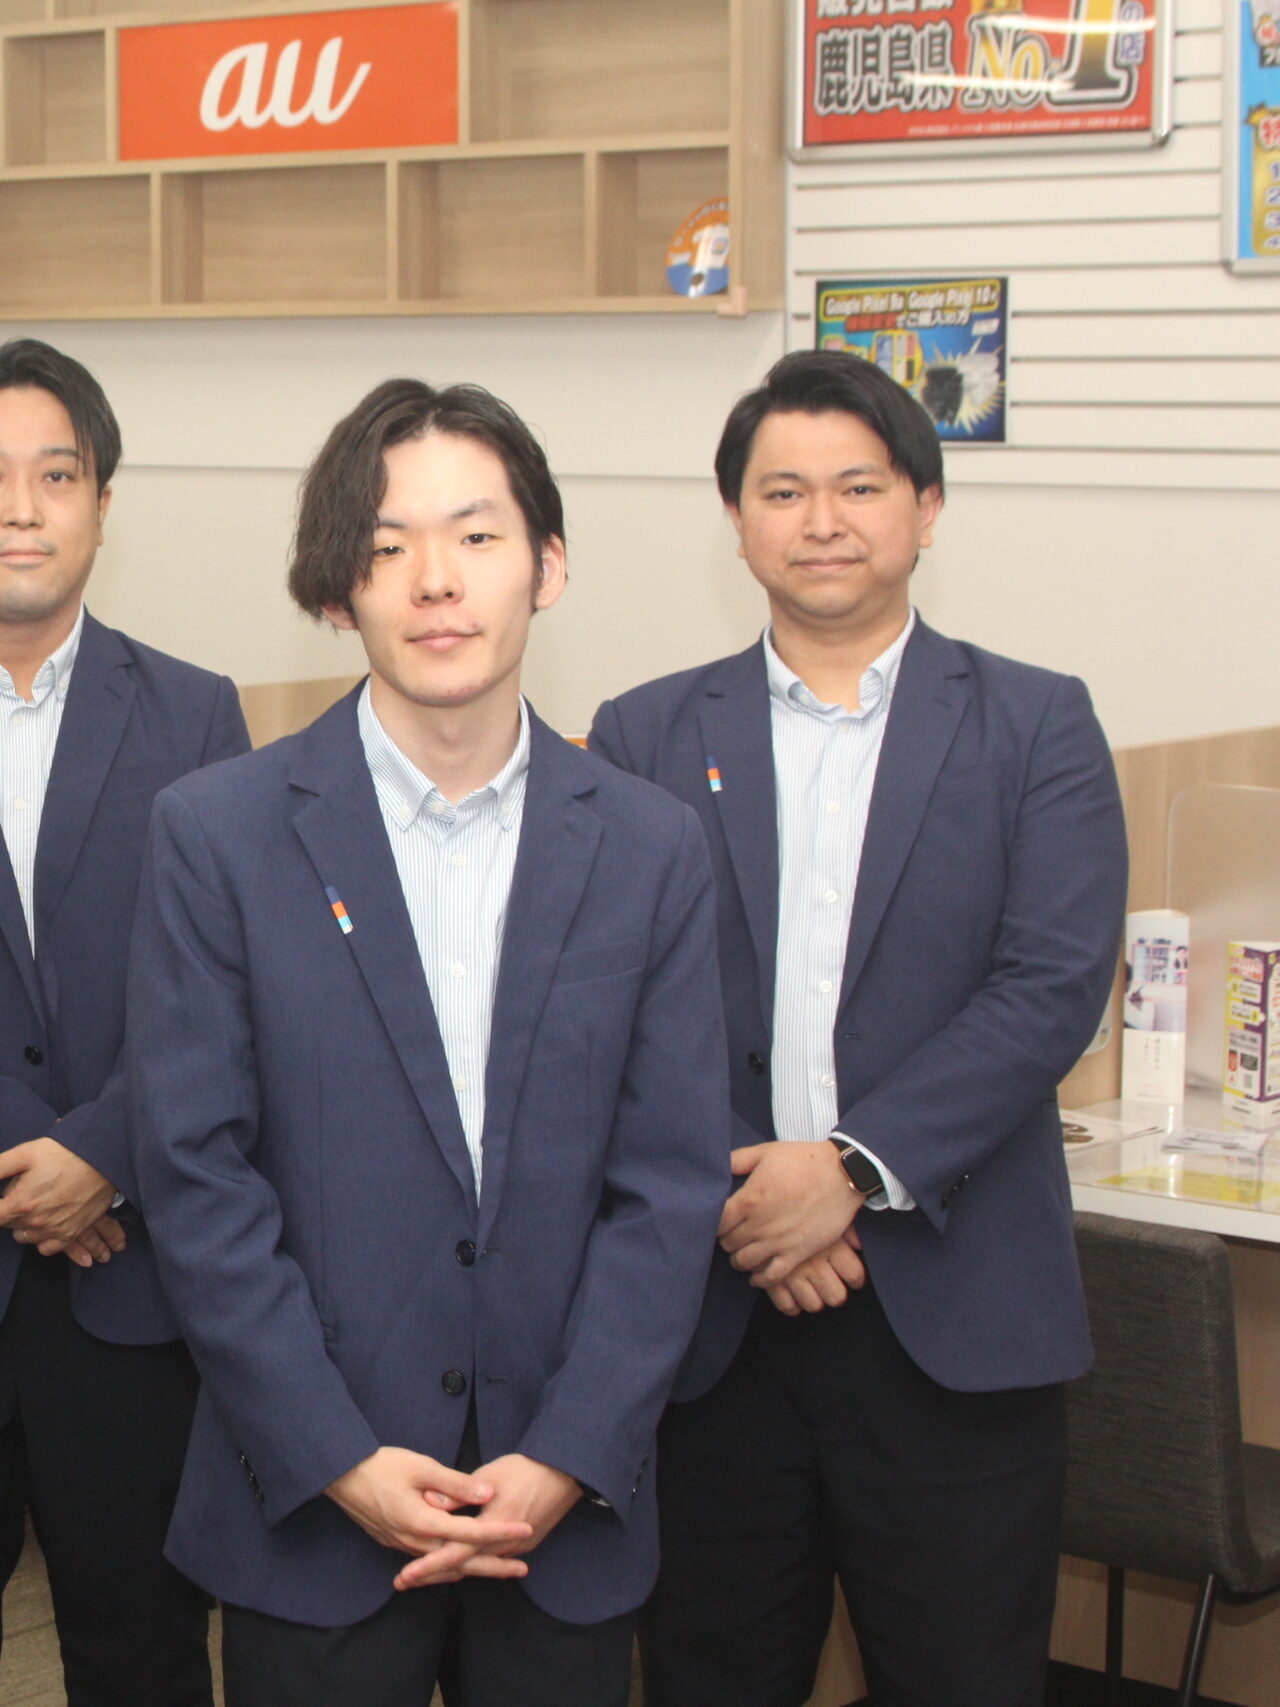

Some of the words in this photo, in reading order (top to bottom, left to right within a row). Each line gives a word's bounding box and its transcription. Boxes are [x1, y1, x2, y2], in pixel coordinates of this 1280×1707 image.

[200, 36, 372, 132] au
[815, 22, 955, 116] 鹿児島県
